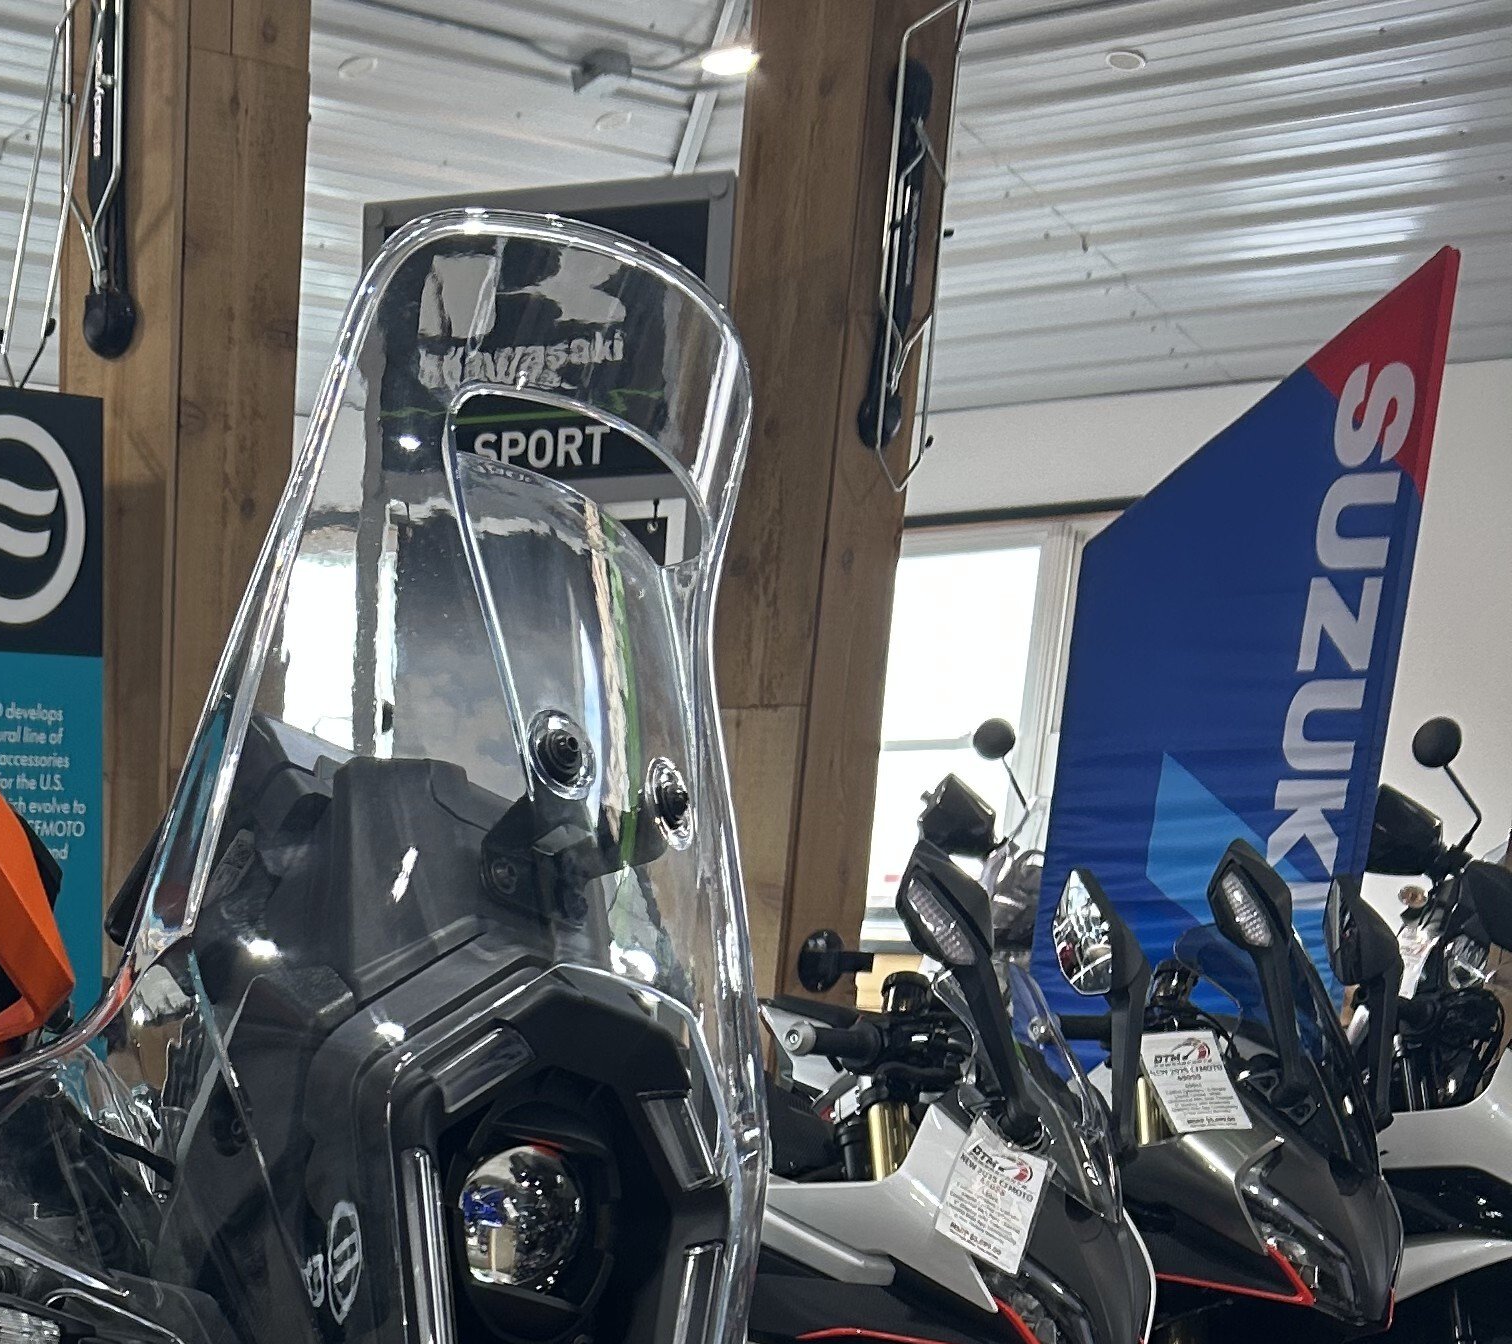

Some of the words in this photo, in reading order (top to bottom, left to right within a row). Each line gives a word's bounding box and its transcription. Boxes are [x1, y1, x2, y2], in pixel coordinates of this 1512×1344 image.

[473, 425, 611, 469] SPORT
[5, 702, 64, 726] develops
[23, 726, 47, 744] line
[49, 727, 64, 744] of
[16, 772, 37, 790] the
[39, 773, 65, 791] U.S.
[29, 796, 70, 815] evolve
[73, 799, 87, 815] to
